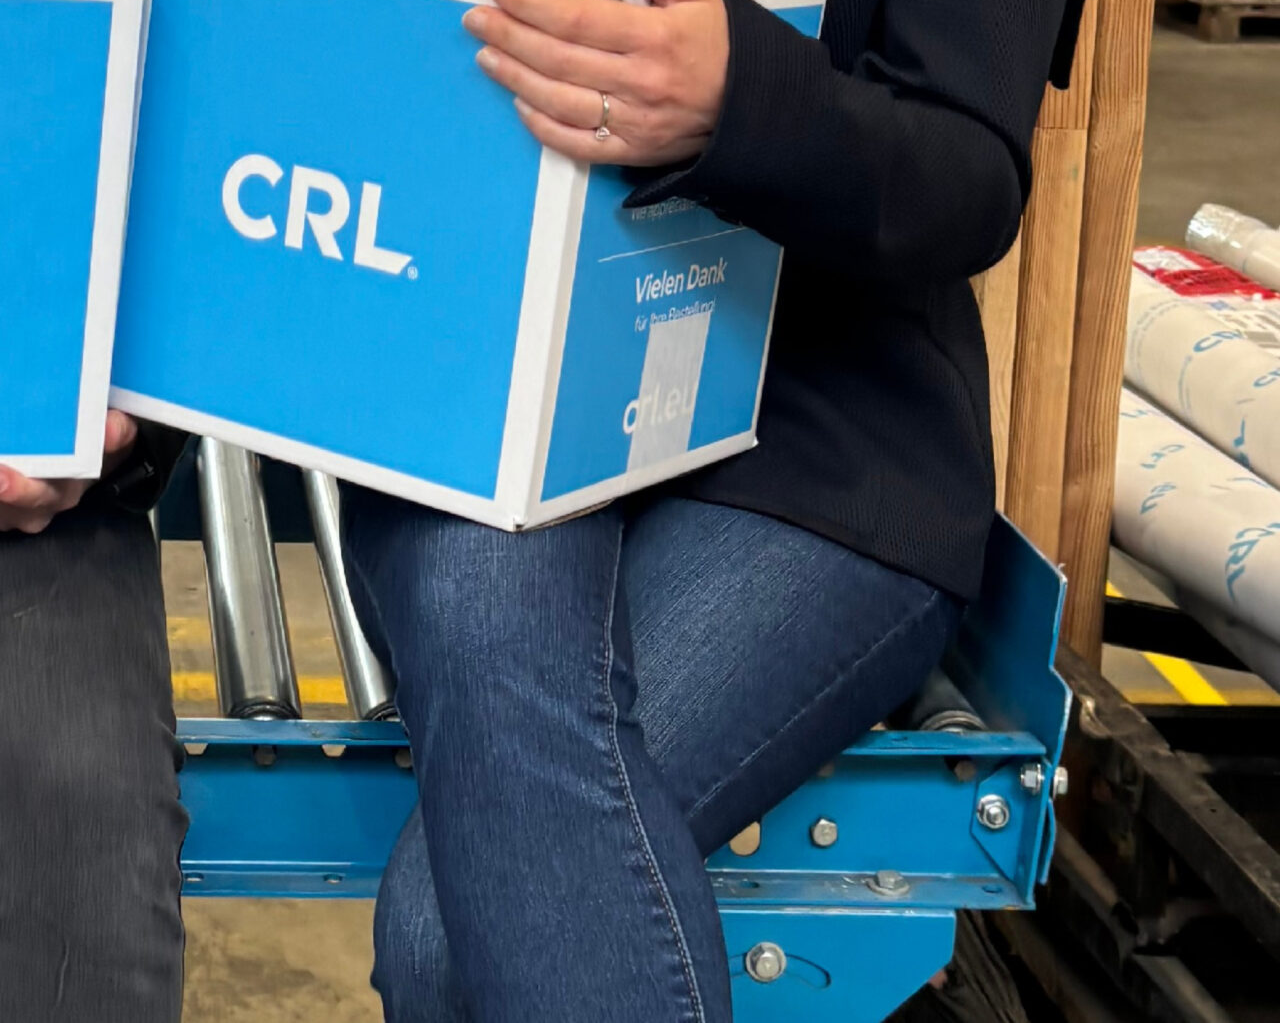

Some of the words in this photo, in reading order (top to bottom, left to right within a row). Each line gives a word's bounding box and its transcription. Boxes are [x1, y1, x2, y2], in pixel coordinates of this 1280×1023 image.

[635, 269, 684, 304] Vielen
[686, 256, 728, 291] Dank
[634, 315, 649, 333] für
